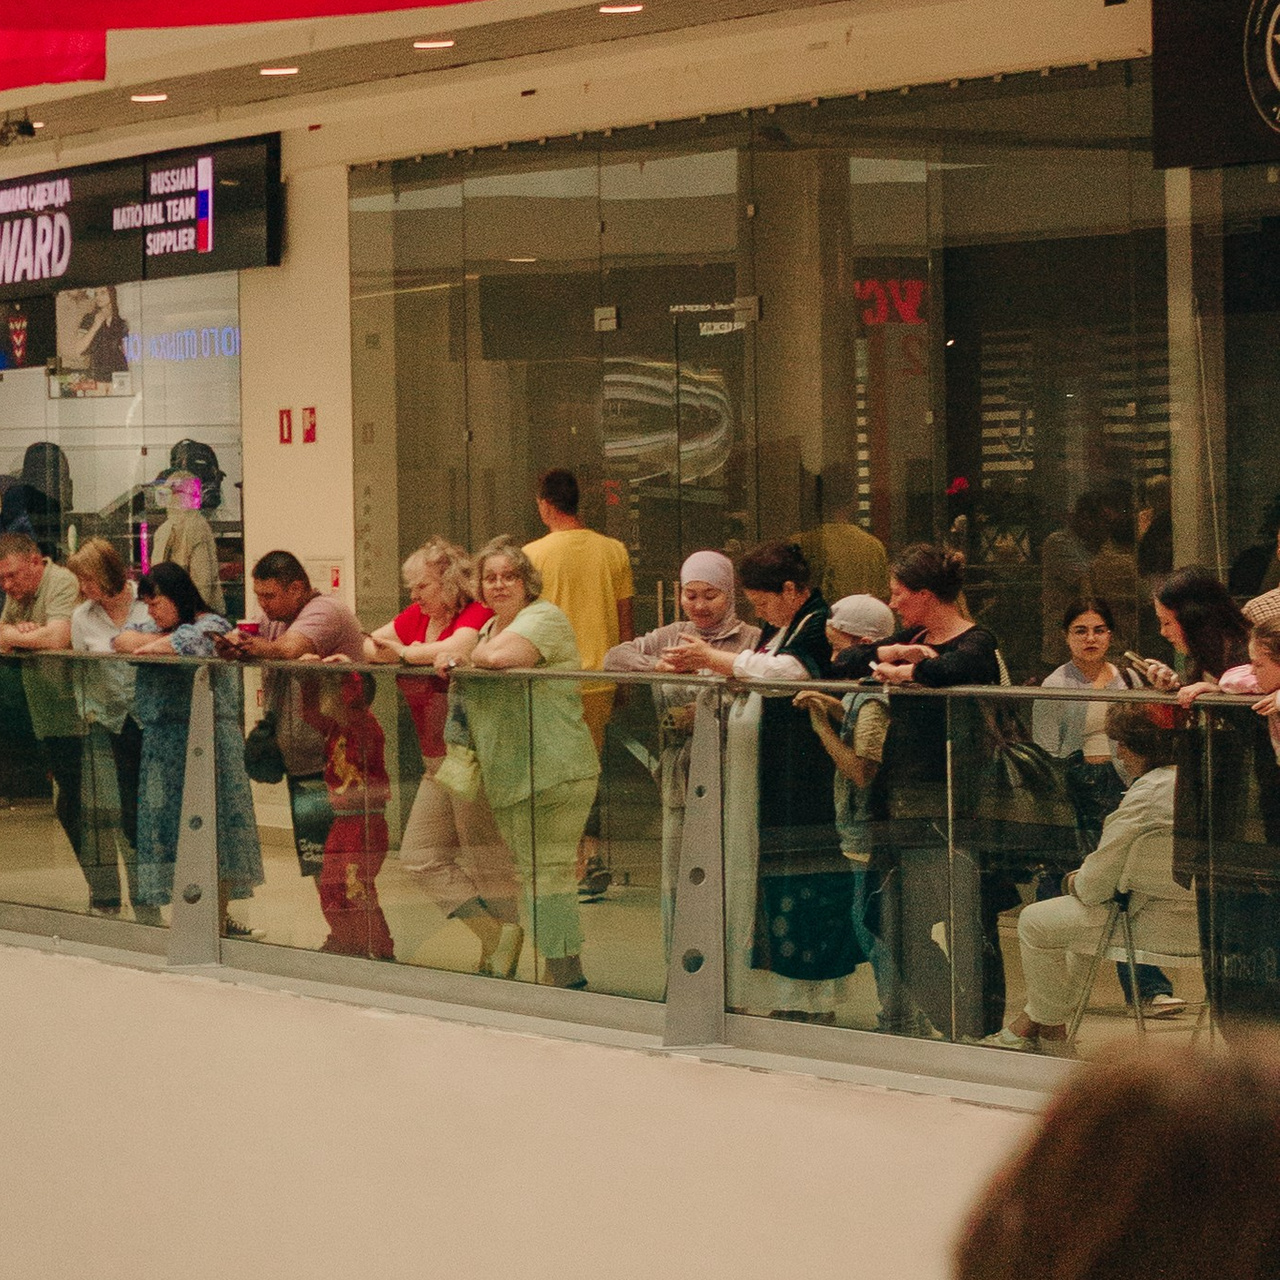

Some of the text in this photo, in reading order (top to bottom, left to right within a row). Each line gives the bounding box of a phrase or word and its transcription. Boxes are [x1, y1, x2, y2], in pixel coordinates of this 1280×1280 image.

[28, 178, 71, 212] ОДЕЖДА
[150, 166, 196, 195] RUSSIAN
[113, 196, 196, 231] NATIONAL TEAM
[145, 227, 196, 256] SUPPLIER
